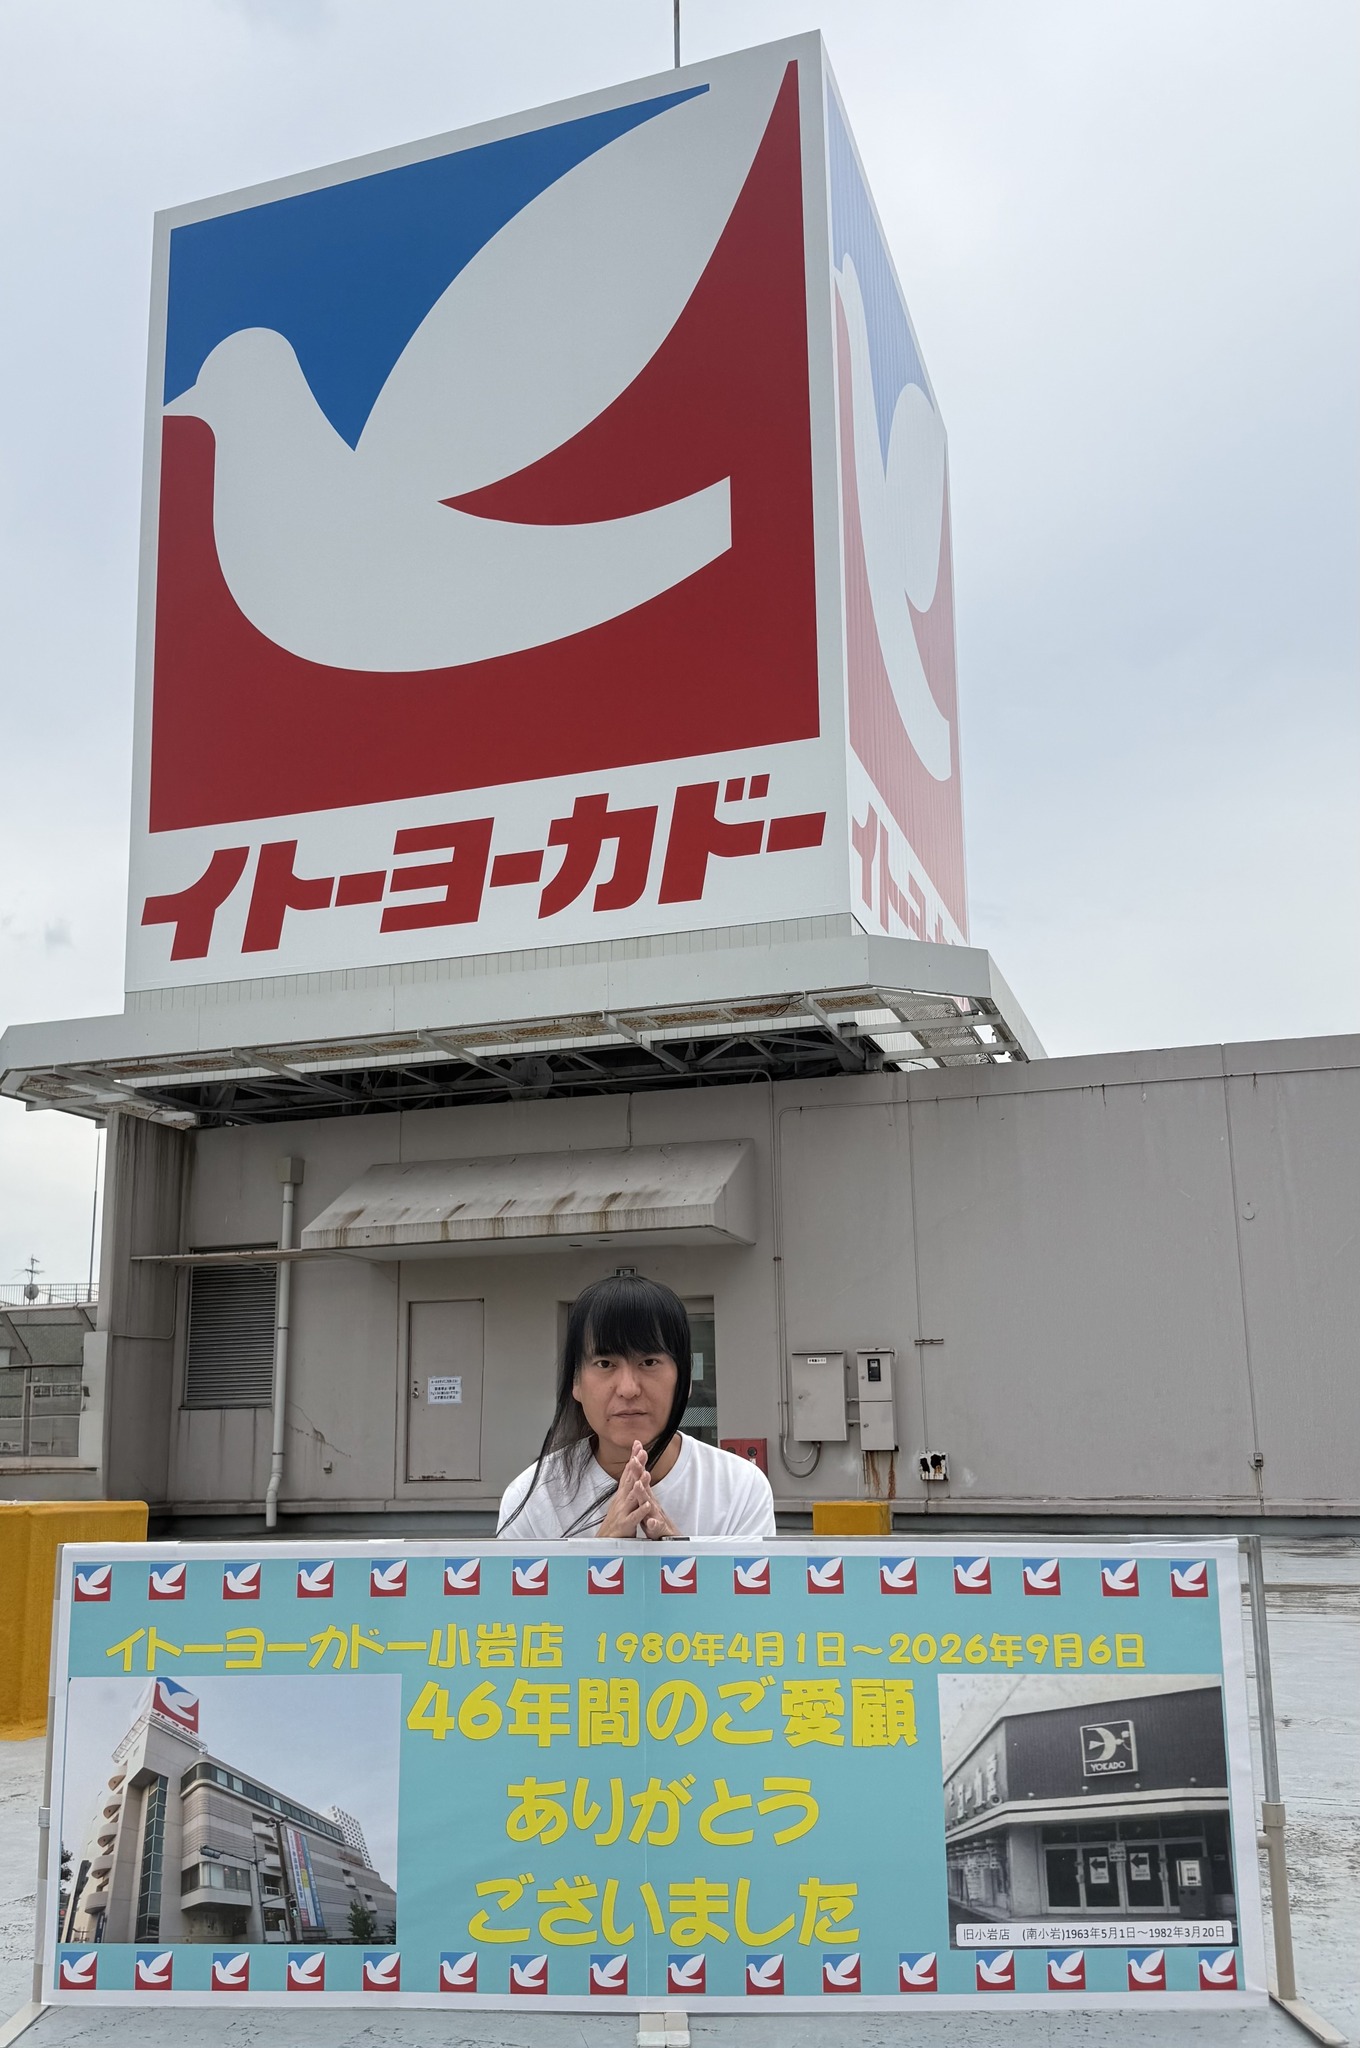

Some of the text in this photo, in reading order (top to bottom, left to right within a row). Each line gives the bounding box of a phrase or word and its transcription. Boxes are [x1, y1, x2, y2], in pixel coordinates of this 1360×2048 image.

[142, 774, 826, 961] イトーヨーカドー
[105, 1622, 563, 1673] イトーヨーカドー小岩店
[406, 1675, 917, 1748] 46年間のご愛顧
[1091, 1761, 1126, 1772] YOKADO
[505, 1774, 819, 1847] ありがとう
[467, 1873, 860, 1948] ございました
[963, 1928, 1010, 1941] 旧小岩店
